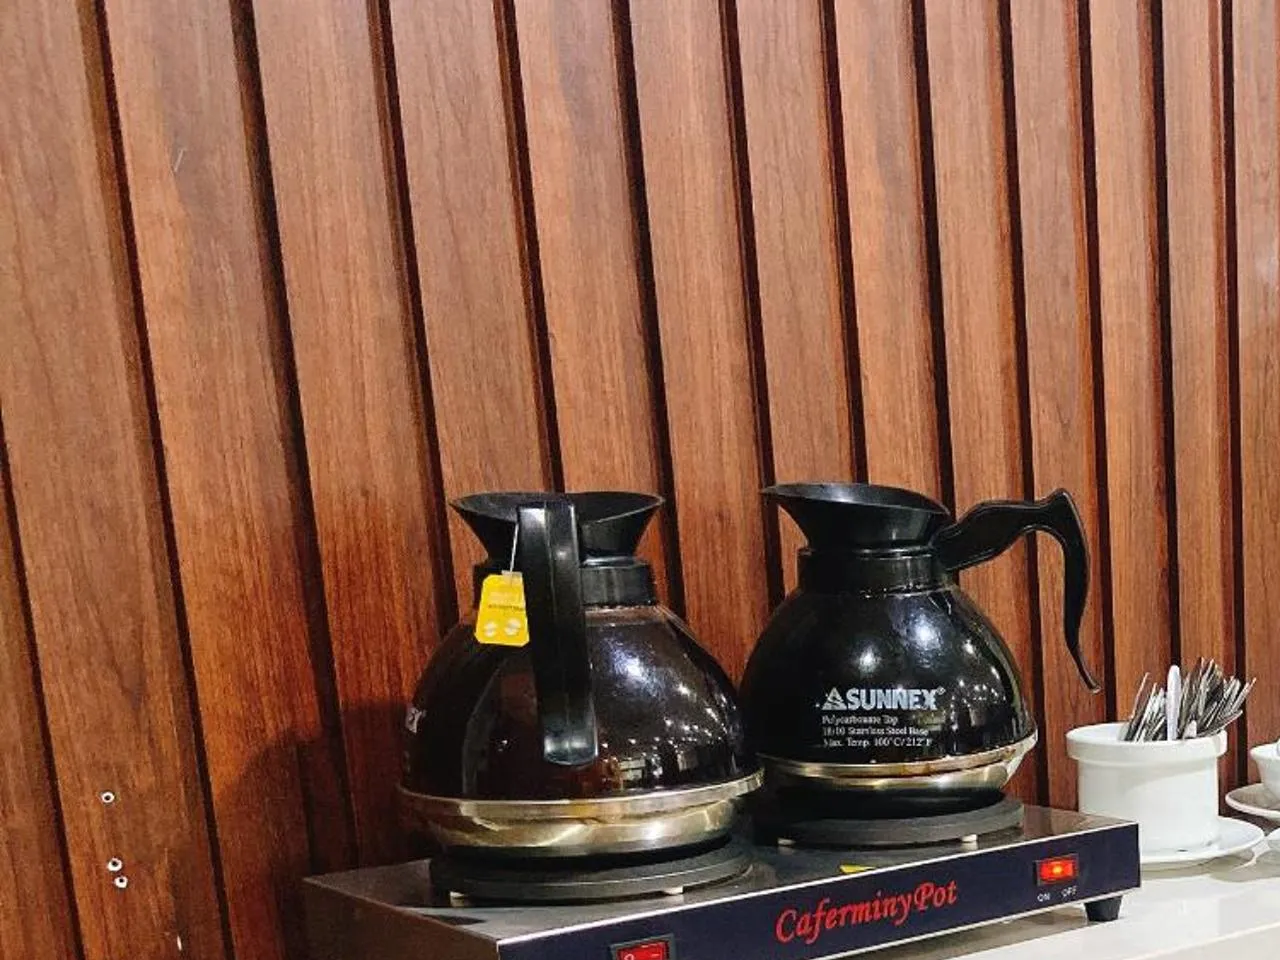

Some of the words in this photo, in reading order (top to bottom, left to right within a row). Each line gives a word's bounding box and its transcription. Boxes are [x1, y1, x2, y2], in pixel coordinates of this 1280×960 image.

[846, 687, 938, 711] SUNNEX
[822, 715, 881, 725] Polycarbonate
[882, 715, 898, 726] Top
[886, 726, 907, 735] Steel
[1037, 892, 1051, 902] ON
[1061, 886, 1078, 898] OFF
